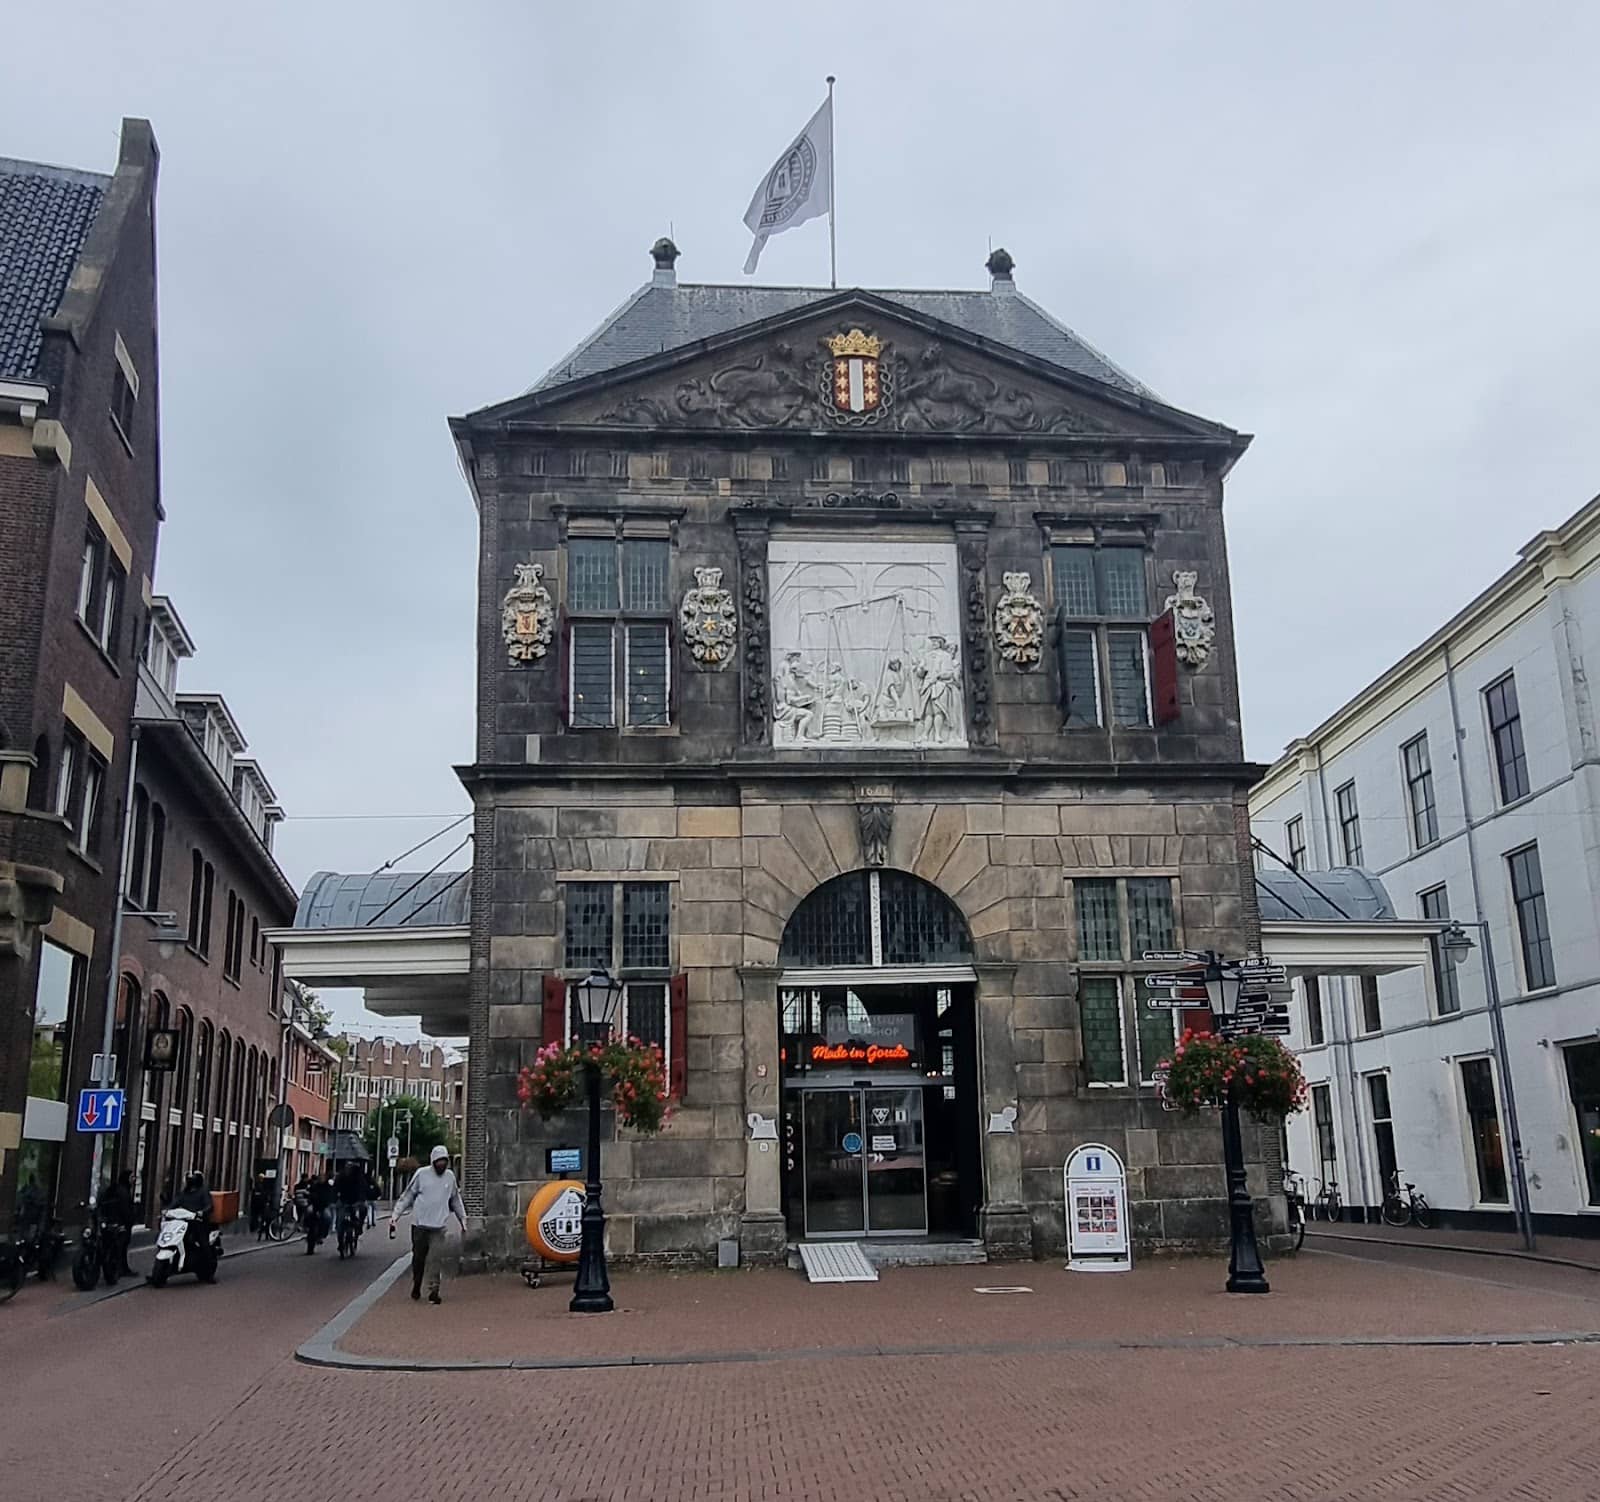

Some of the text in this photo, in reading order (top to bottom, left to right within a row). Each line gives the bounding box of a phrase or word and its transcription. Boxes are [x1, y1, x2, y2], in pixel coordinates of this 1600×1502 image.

[1246, 959, 1260, 967] AED
[812, 1043, 909, 1063] Made in Gouda
